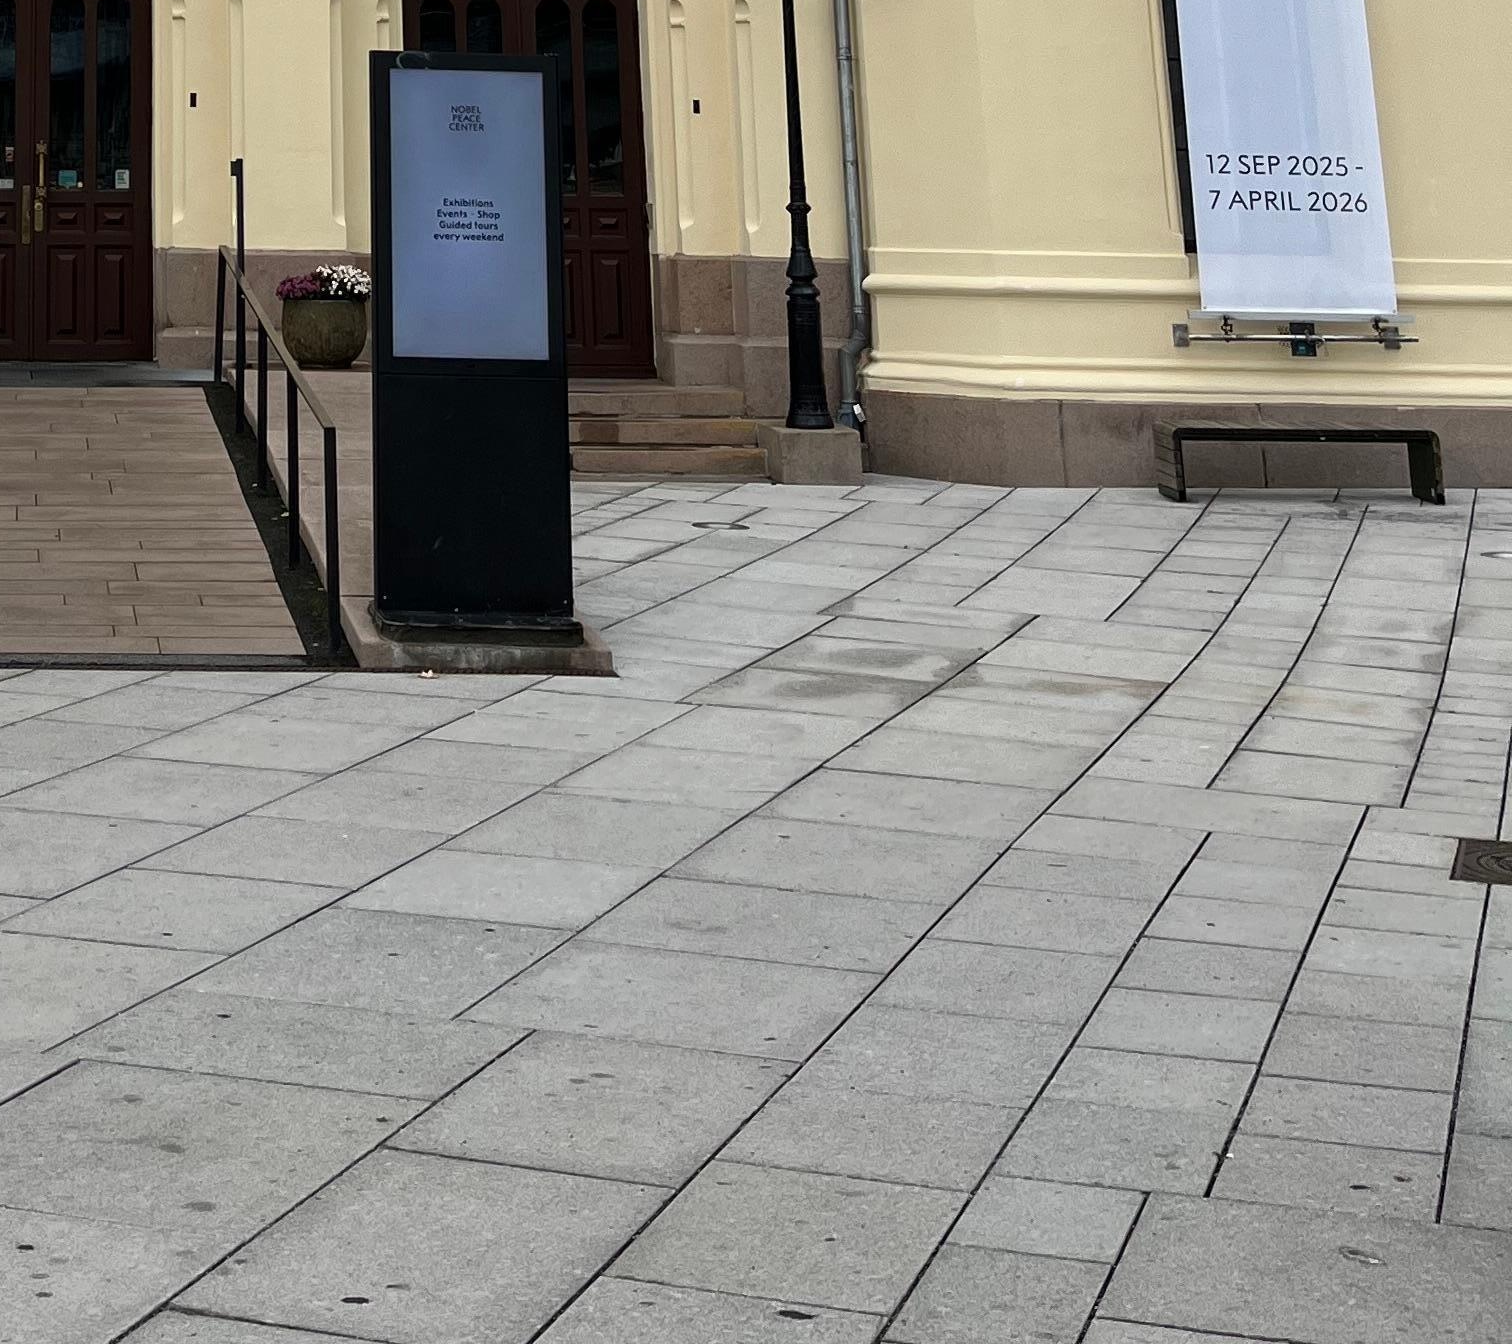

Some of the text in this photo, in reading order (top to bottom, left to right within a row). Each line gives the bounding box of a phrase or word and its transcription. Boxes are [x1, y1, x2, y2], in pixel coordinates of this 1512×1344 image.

[451, 105, 482, 114] NOBEL
[452, 114, 481, 122] PEACE
[448, 123, 484, 132] CENTER
[1206, 154, 1230, 174] 12
[1239, 155, 1280, 174] SEP
[1287, 156, 1348, 176] 2025
[443, 198, 494, 208] Exhibitions
[1209, 190, 1367, 212] 7 APRIL 2026
[436, 209, 501, 220] Events Shop
[439, 221, 499, 230] Guided tours
[433, 233, 505, 242] every weekend
